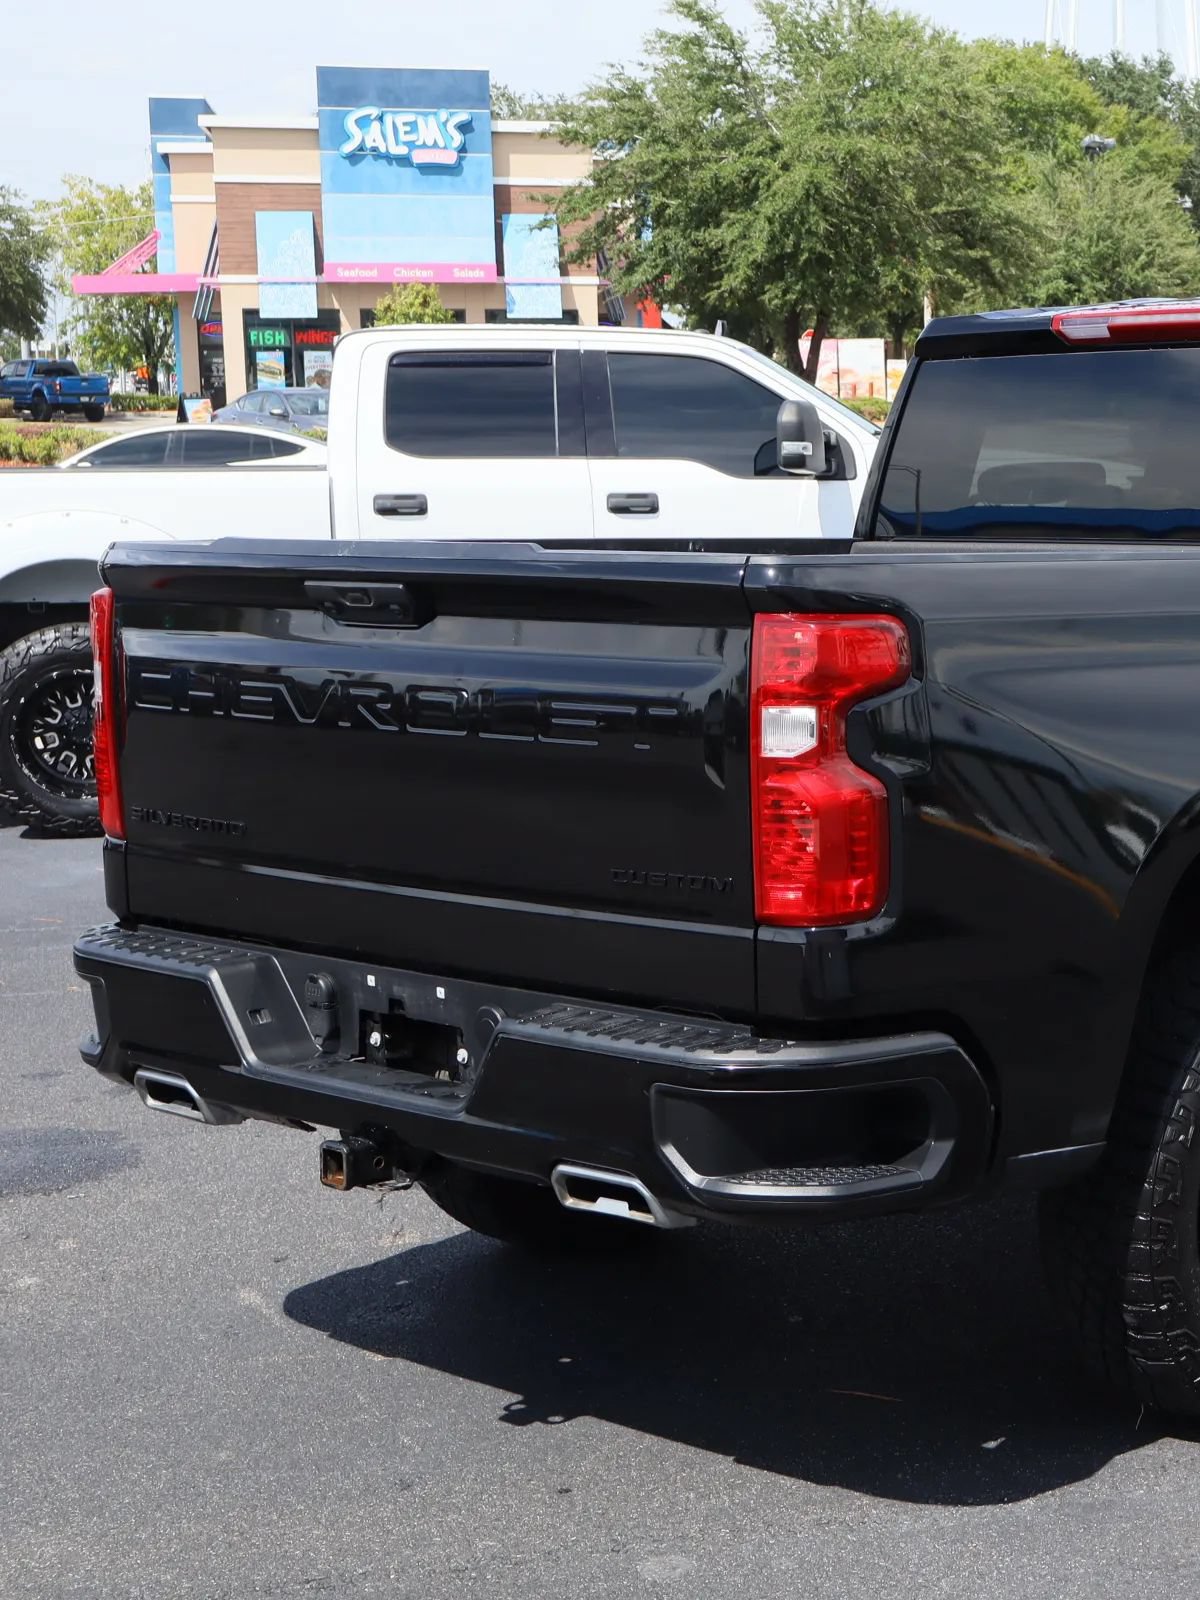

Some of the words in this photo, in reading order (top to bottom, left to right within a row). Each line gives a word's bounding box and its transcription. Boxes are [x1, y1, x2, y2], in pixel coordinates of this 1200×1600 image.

[337, 267, 379, 278] Seafood
[393, 267, 434, 278] Chicken
[453, 267, 485, 278] Salads
[250, 330, 285, 346] FISH
[134, 668, 690, 750] CHEVROLET
[130, 805, 248, 837] SILVERADO
[609, 867, 735, 893] CUSTOM
